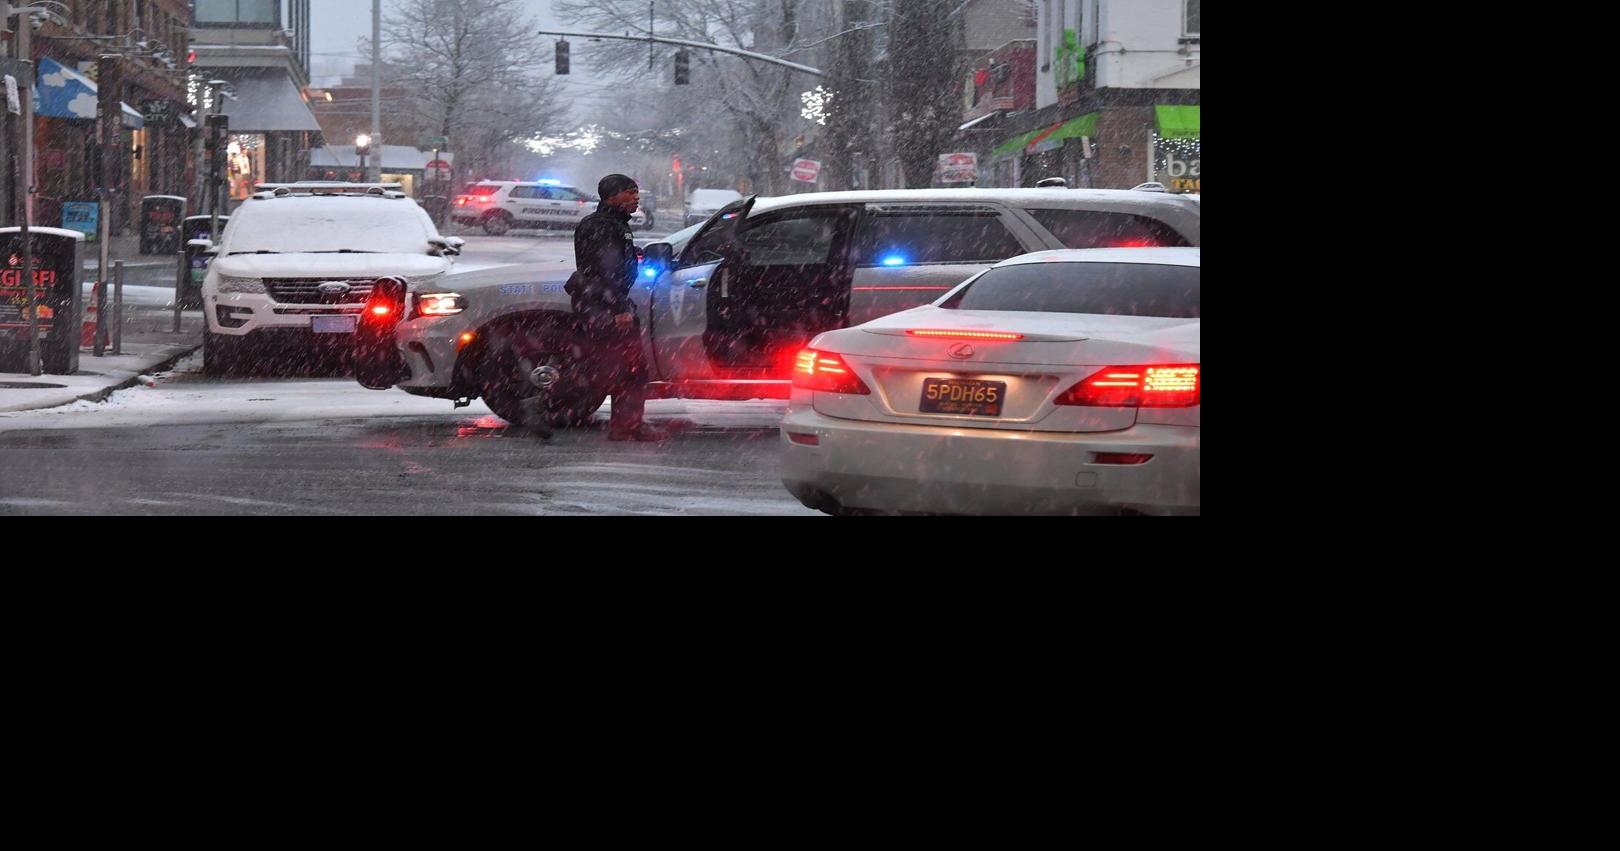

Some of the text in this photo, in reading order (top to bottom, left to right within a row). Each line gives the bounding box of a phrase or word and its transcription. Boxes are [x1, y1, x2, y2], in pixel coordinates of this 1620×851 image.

[143, 113, 169, 122] CITY
[521, 207, 580, 216] PROVIDENCE
[0, 269, 21, 287] GI
[499, 283, 565, 295] STATE POL
[926, 383, 998, 403] 5PDH65
